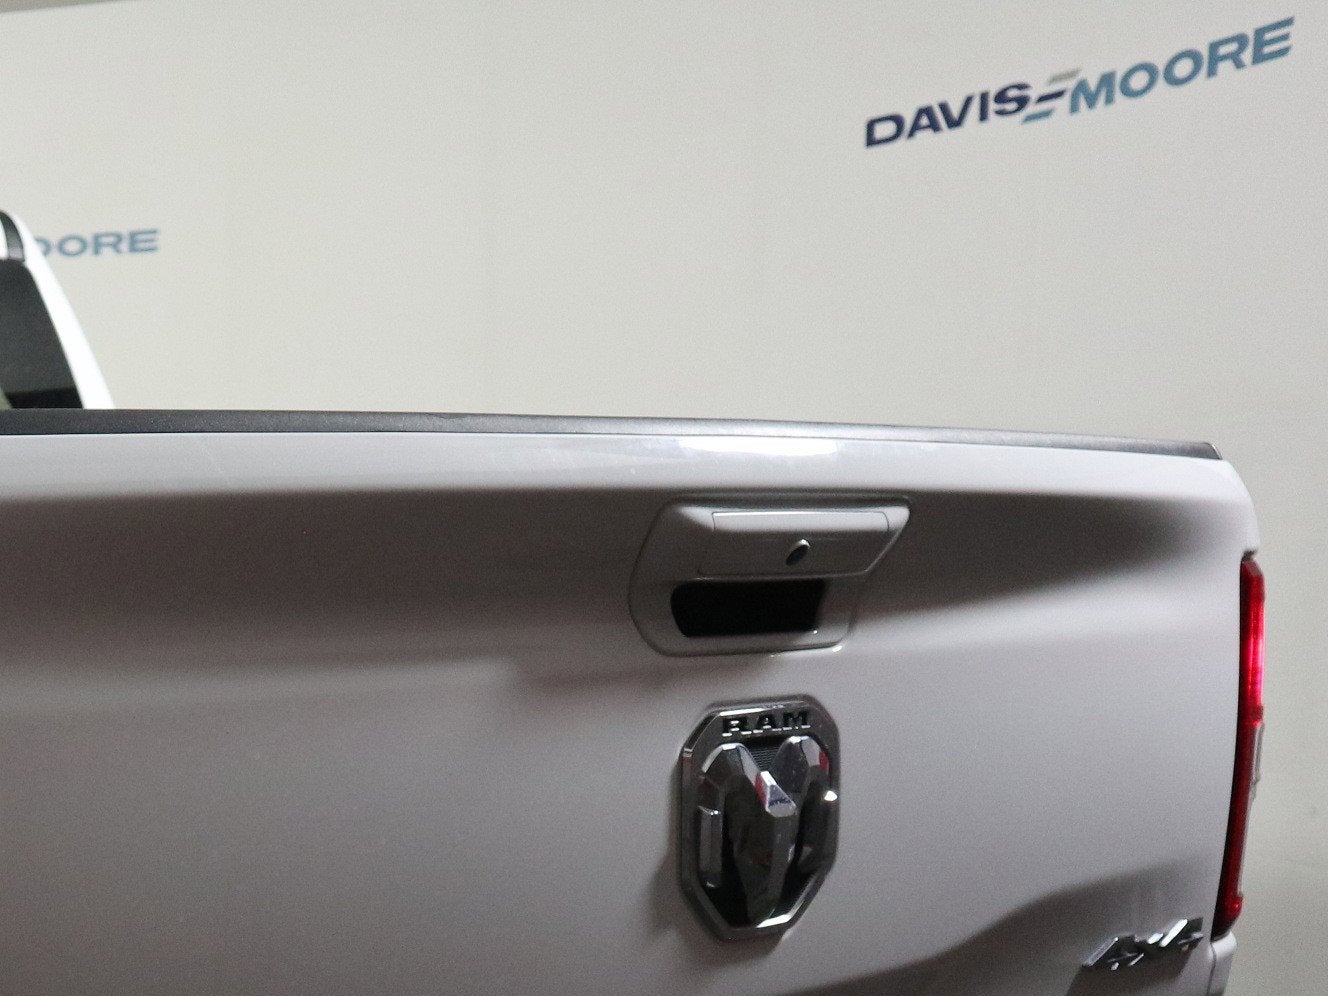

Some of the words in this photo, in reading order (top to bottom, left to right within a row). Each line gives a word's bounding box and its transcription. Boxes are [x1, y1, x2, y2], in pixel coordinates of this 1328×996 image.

[865, 83, 1032, 148] DAVIS
[1068, 16, 1295, 114] MOORE
[35, 230, 159, 257] ORE
[721, 709, 811, 737] RAM
